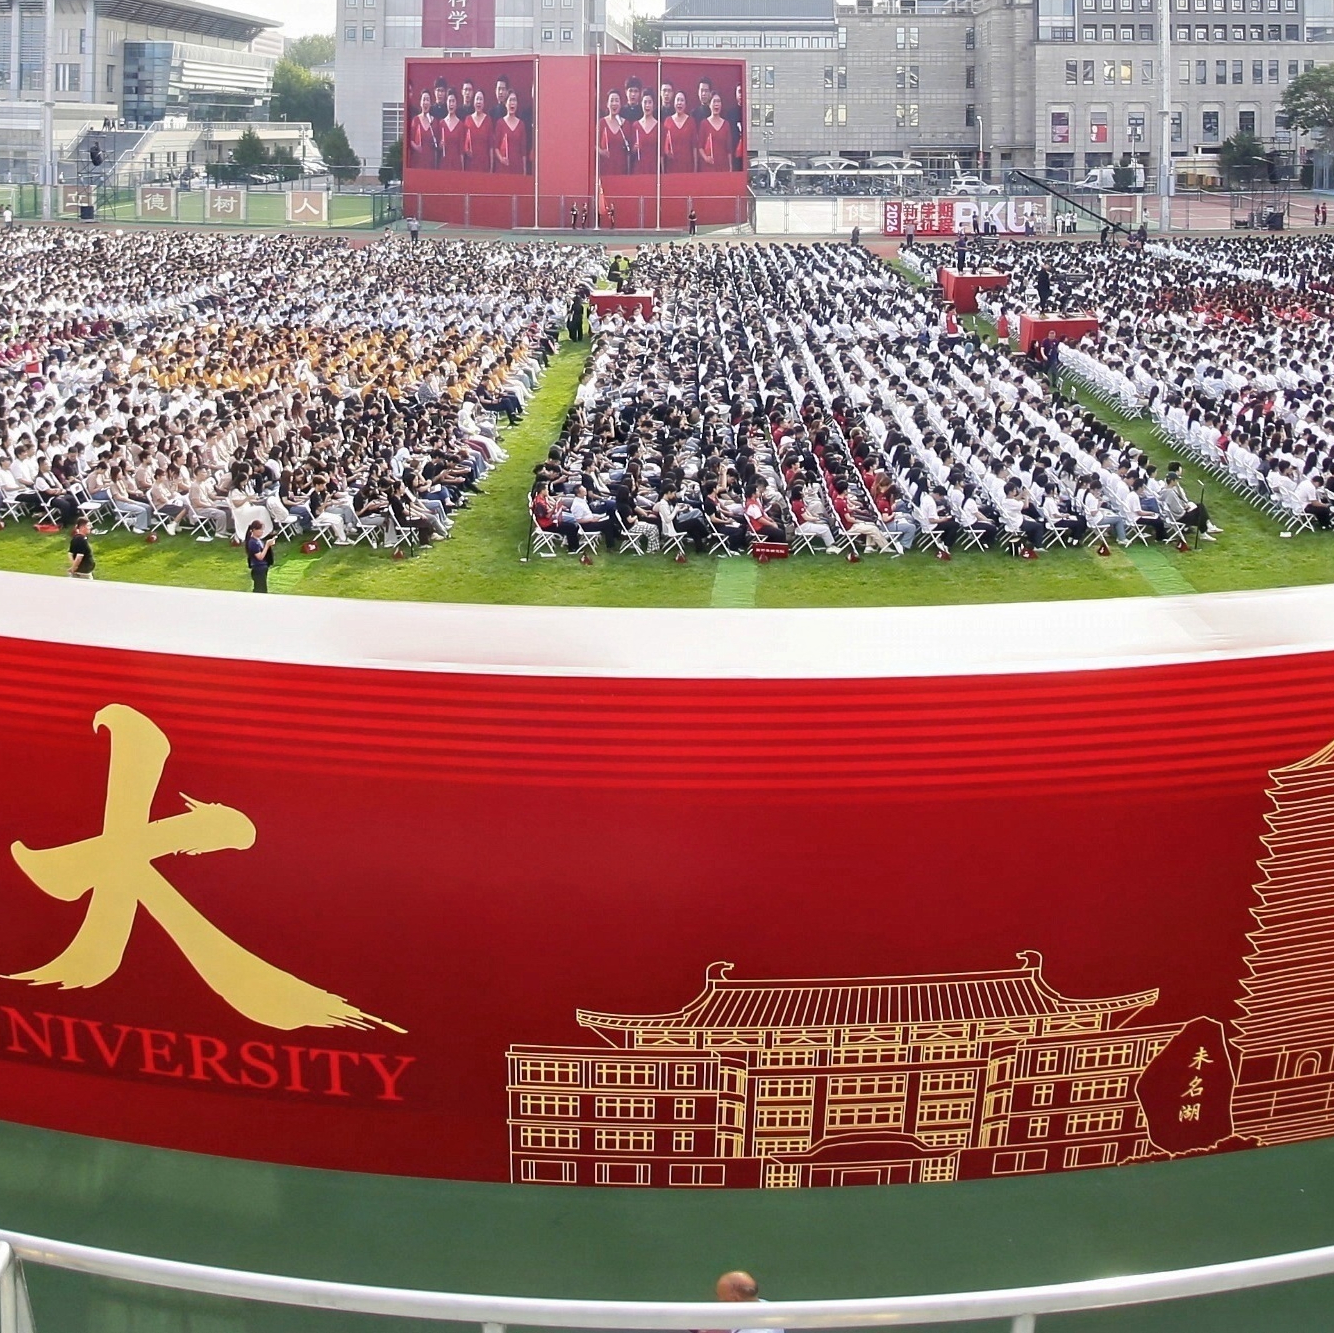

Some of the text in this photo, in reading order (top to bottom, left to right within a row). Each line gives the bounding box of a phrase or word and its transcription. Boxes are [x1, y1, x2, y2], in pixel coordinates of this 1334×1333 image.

[887, 204, 898, 232] 2026
[954, 202, 1032, 233] PKU
[1178, 1046, 1215, 1123] 未名湖
